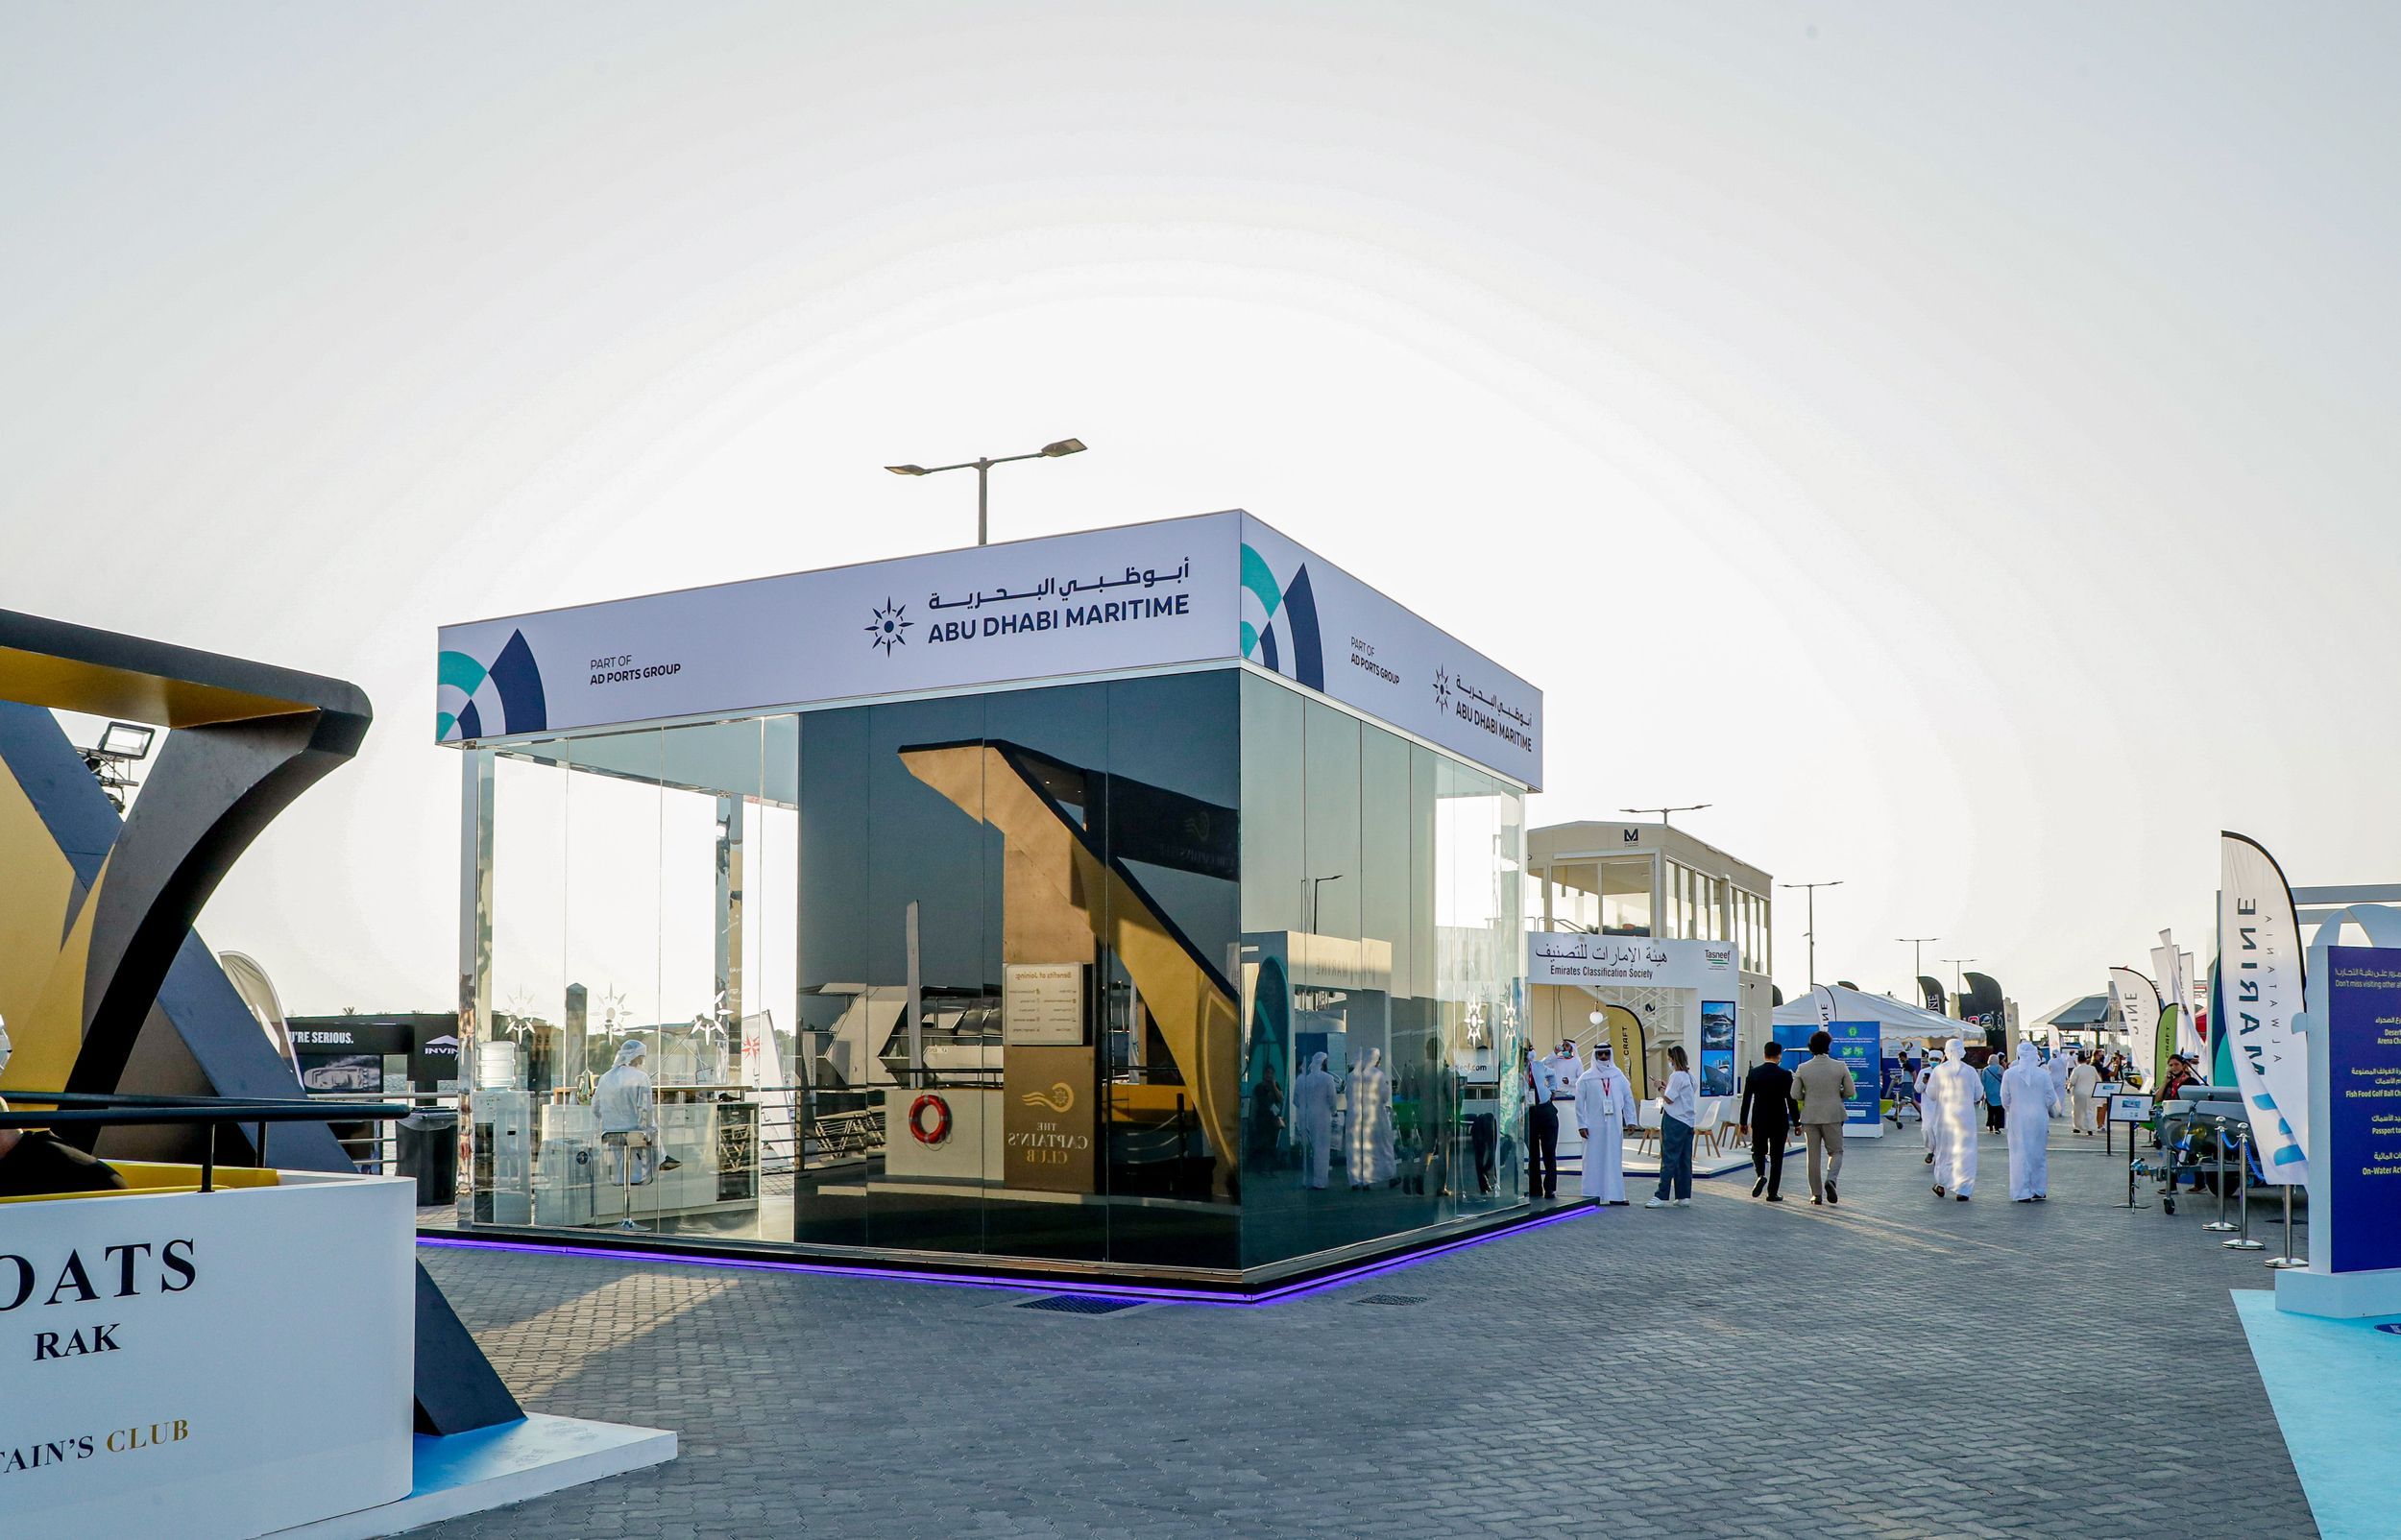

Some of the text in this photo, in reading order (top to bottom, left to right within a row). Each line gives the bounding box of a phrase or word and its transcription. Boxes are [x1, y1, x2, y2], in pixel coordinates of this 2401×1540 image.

[928, 557, 1190, 610] أبوظبي البحرية
[928, 593, 1190, 643] ABU DHABI MARITIME
[1351, 636, 1375, 657] PART OF
[590, 655, 632, 670] PART OF
[1351, 653, 1399, 686] AD PORTS GROUP
[590, 663, 681, 685] AD PORTS GROUP
[1456, 700, 1532, 753] ABU DHABI MARITIME
[1536, 942, 1667, 967] هيئة الإمارات للتصنيف
[1705, 950, 1730, 962] Tasneef
[1550, 965, 1653, 980] Emirates Classification Society
[2364, 980, 2382, 989] visiting
[288, 1031, 353, 1045] U'RE SERIOUS.
[1458, 1063, 1487, 1071] eef.com
[2372, 1127, 2394, 1136] Passport
[2363, 1167, 2392, 1175] On-Water
[0, 1239, 196, 1311] OATS
[33, 1323, 121, 1361] RAK
[107, 1419, 188, 1453] CLUB
